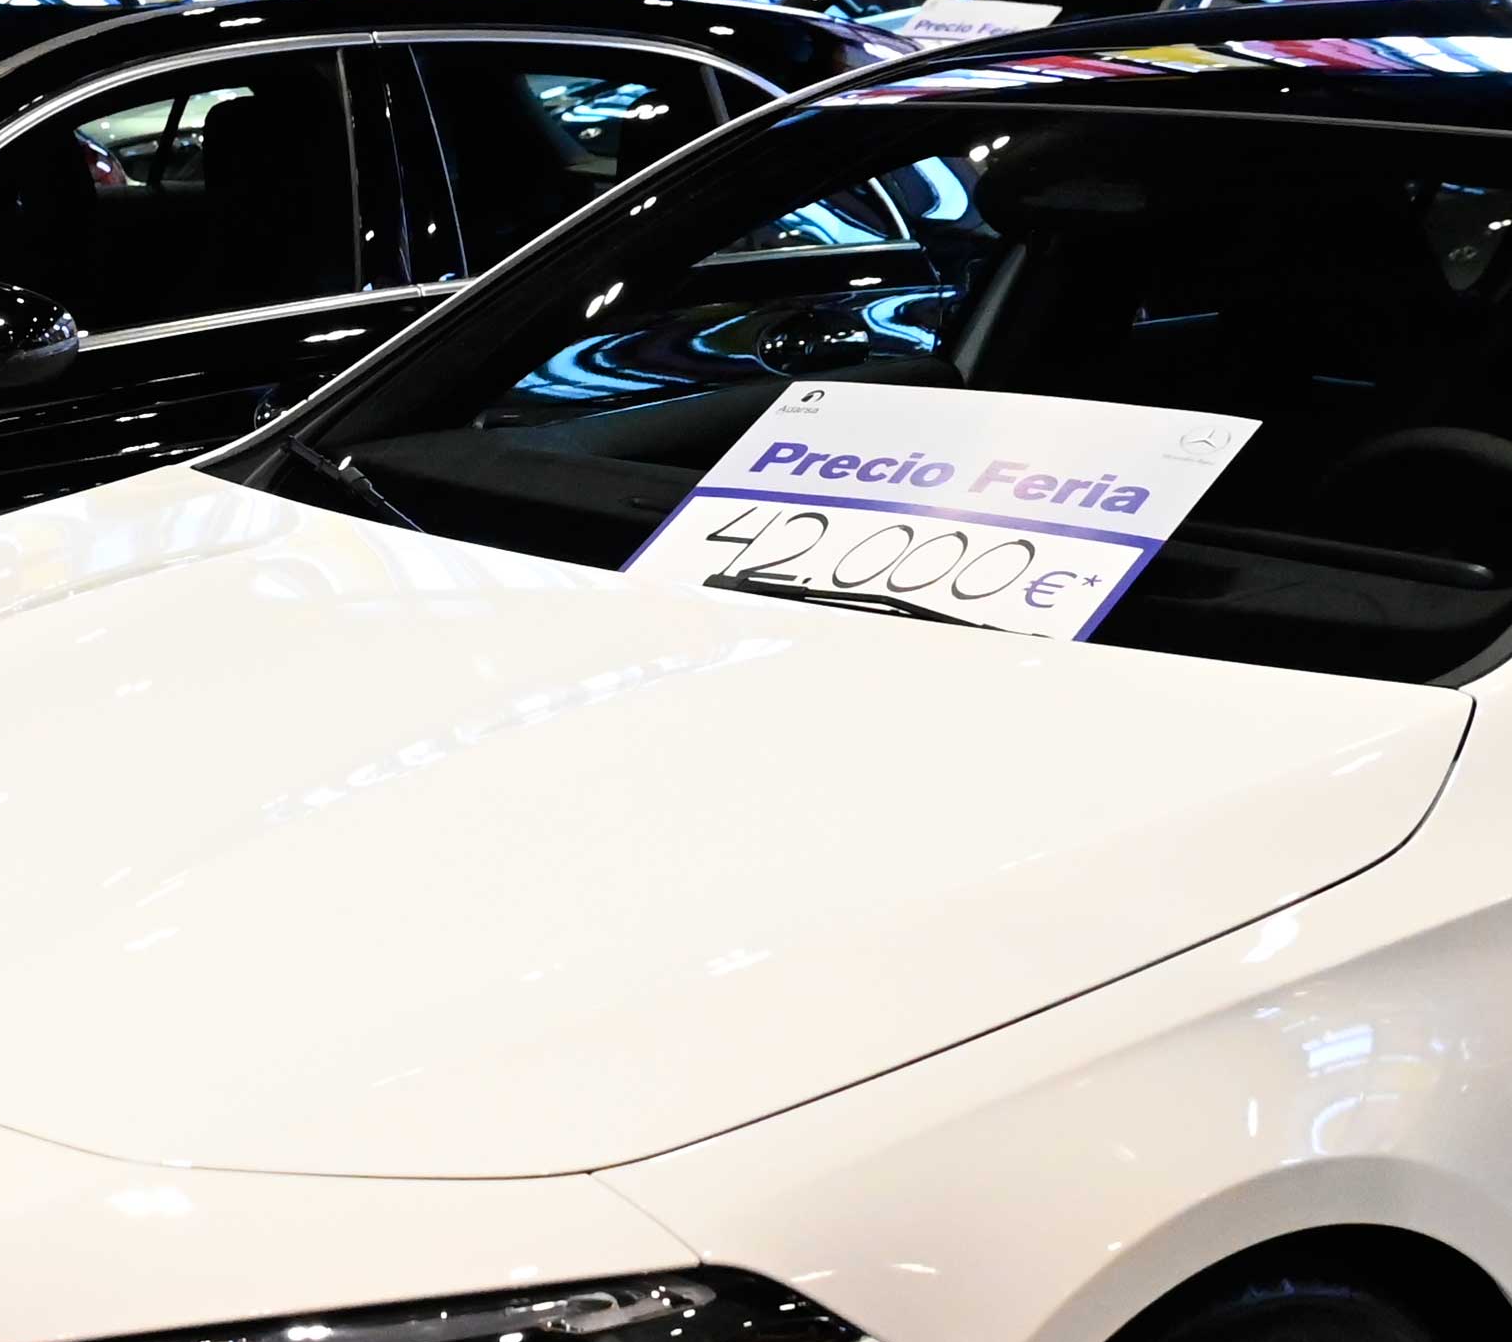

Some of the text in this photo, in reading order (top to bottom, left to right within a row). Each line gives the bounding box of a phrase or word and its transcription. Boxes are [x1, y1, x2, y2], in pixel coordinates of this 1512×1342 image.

[913, 18, 973, 33] Precio
[748, 441, 1153, 515] Precio Feria
